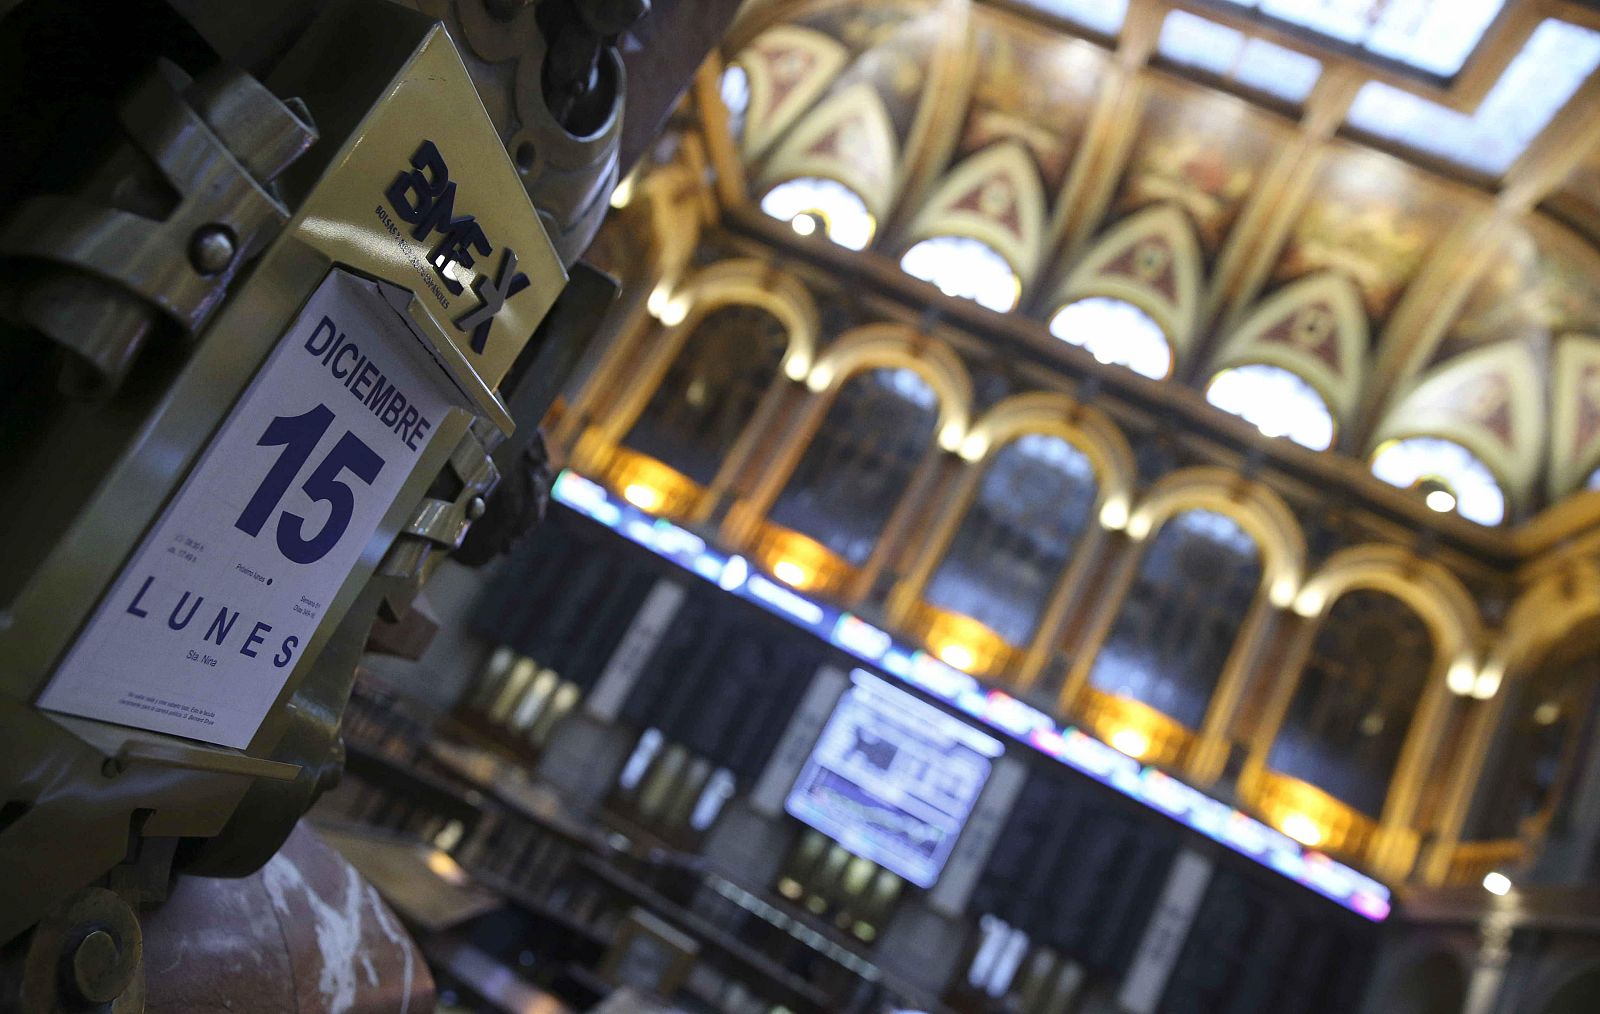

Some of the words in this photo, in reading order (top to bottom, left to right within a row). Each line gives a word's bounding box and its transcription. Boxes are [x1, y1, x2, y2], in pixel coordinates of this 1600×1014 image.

[375, 205, 398, 235] BOLSAS
[304, 315, 432, 452] DICIEMBRE
[234, 403, 386, 565] 15
[127, 576, 299, 668] LUNES
